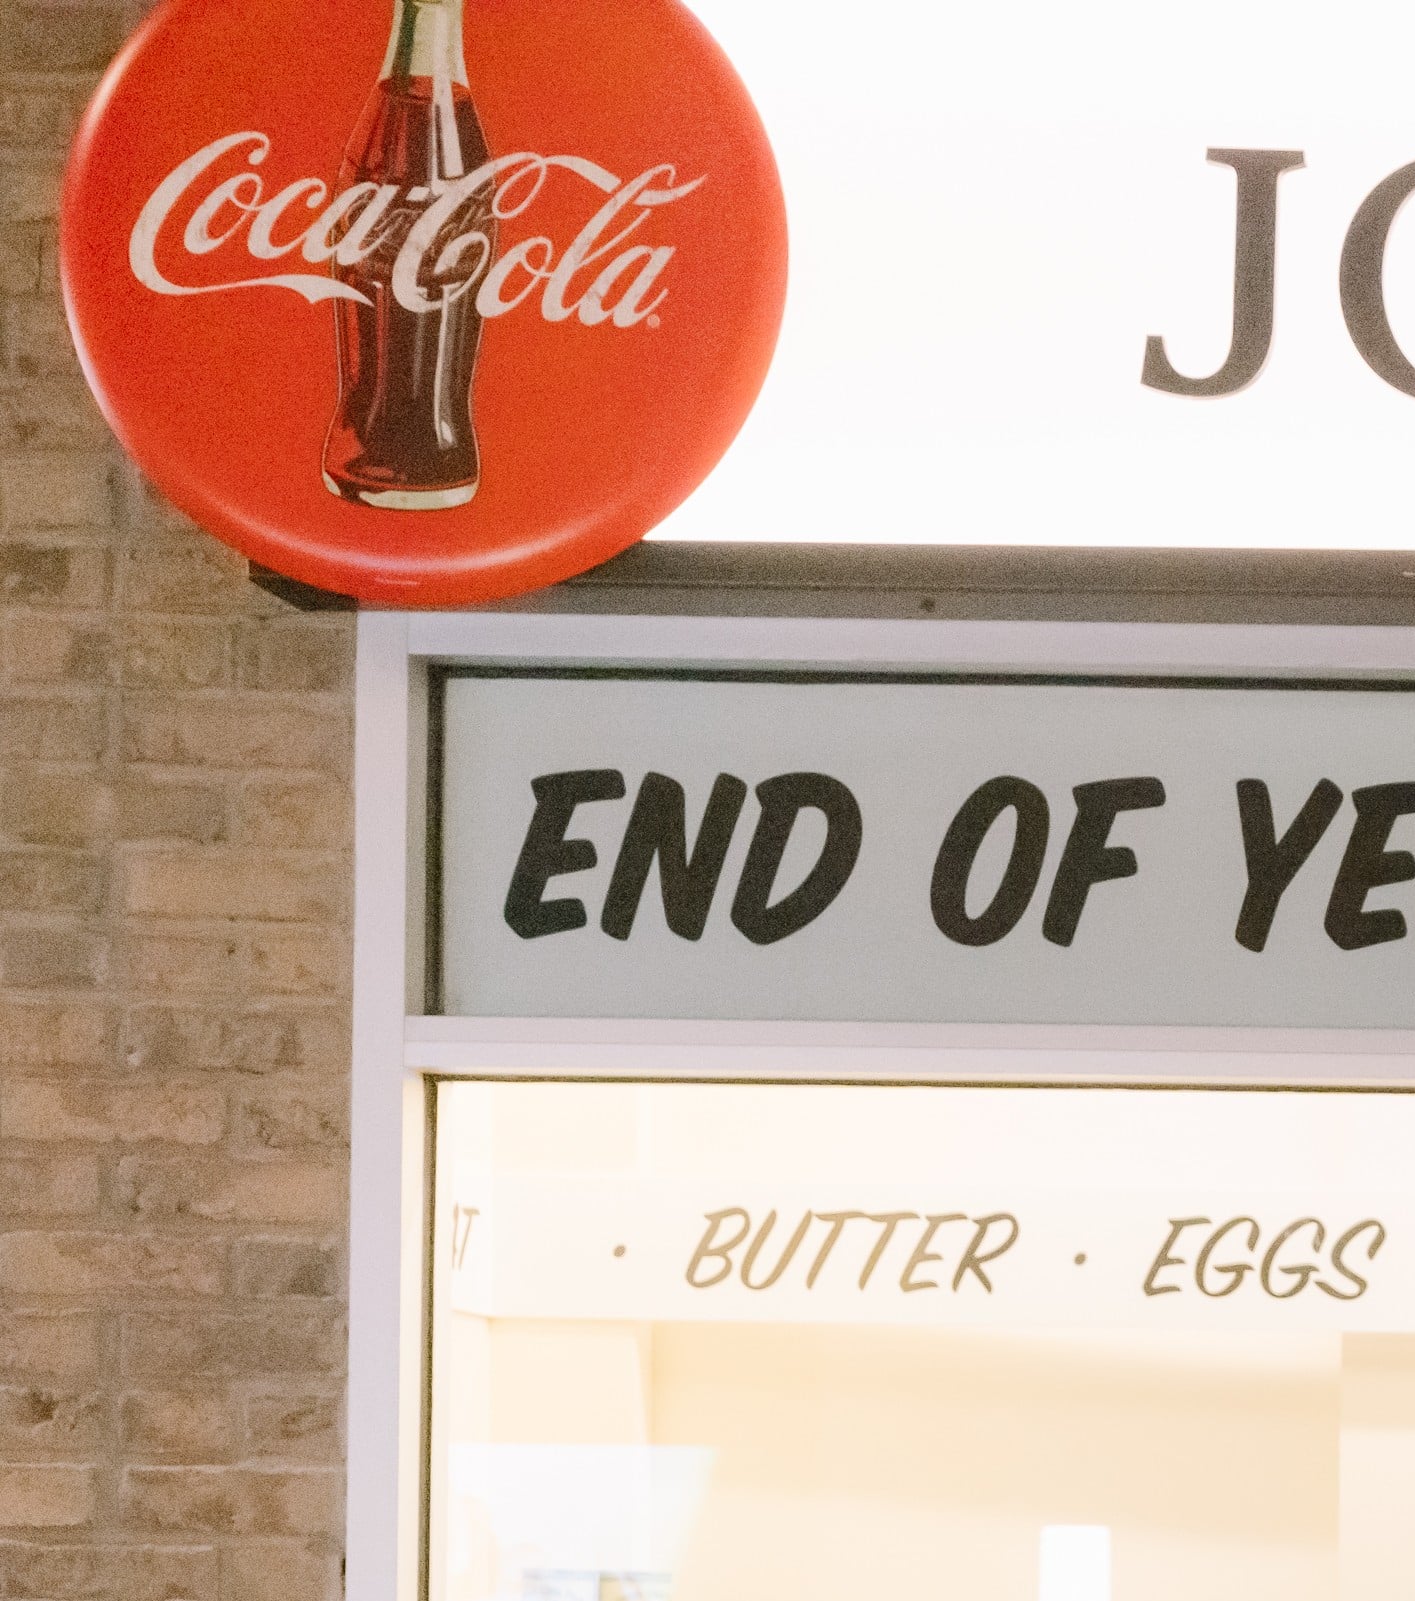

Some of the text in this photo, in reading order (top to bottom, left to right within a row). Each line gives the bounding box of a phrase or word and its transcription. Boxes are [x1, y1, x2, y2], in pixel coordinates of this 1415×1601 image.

[129, 130, 706, 329] Coca-Cola
[503, 768, 864, 945] END
[929, 773, 1167, 948] OF
[684, 1207, 1020, 1294] BUTTER
[1143, 1216, 1386, 1301] EGGS
